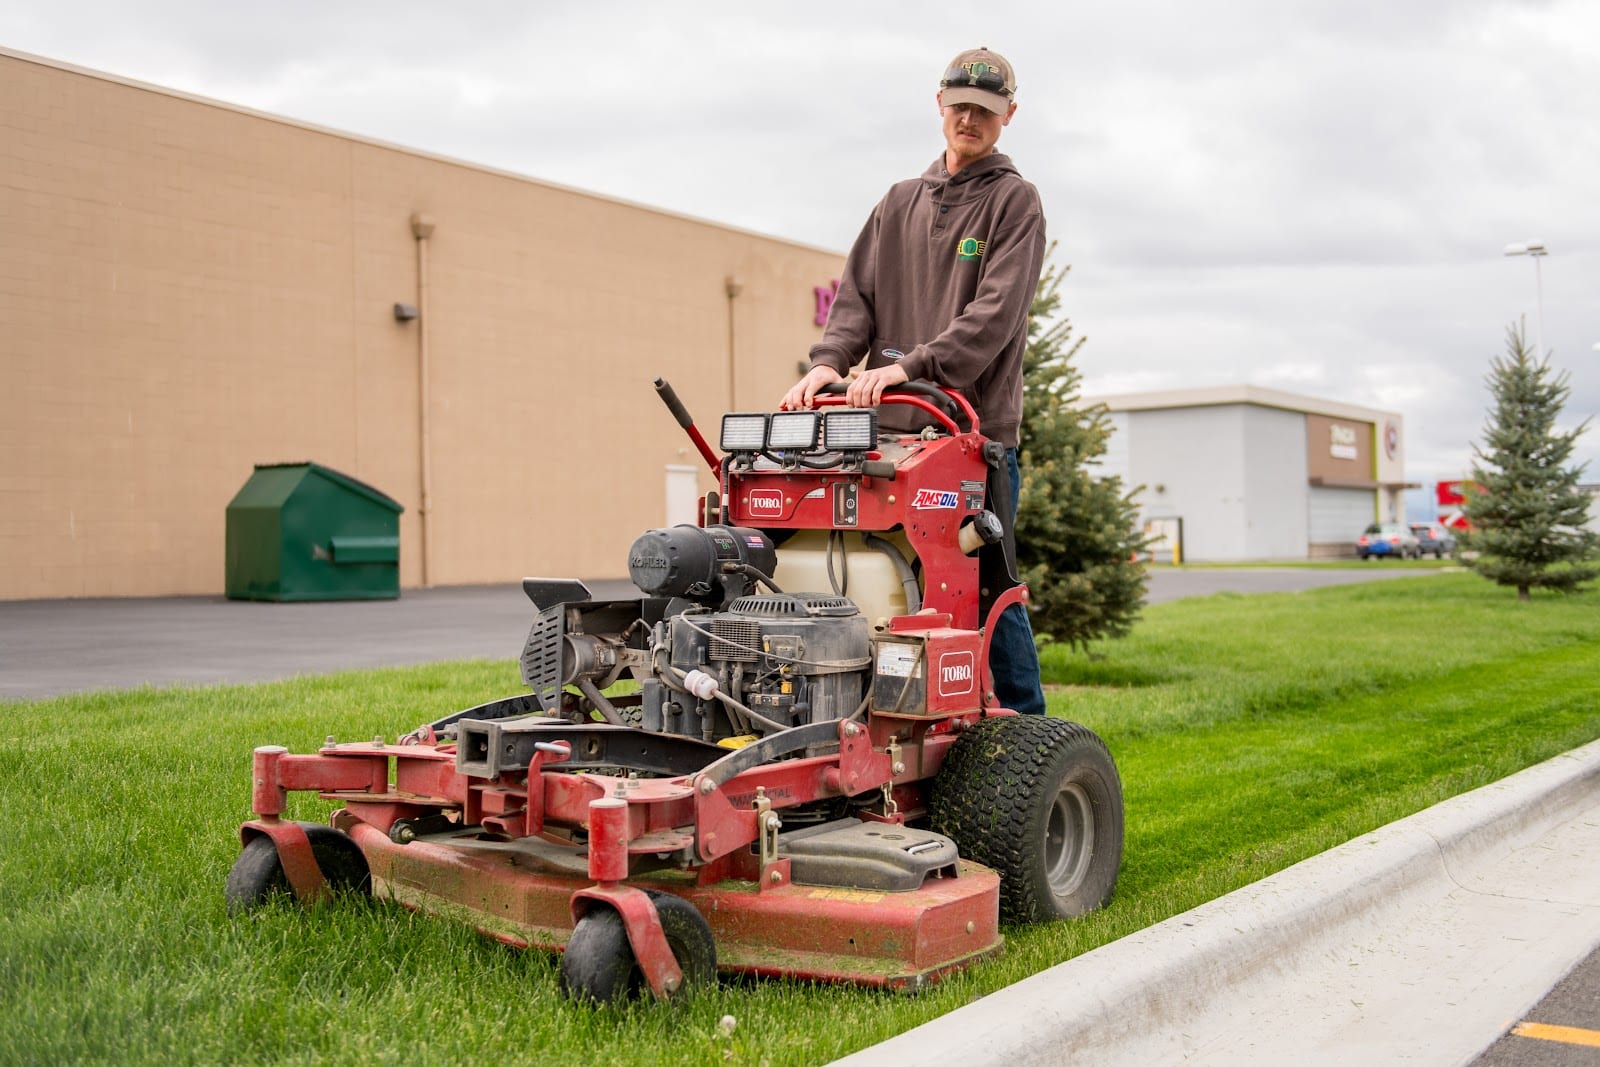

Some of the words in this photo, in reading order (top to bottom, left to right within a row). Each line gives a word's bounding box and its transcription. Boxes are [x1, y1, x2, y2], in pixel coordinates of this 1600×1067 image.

[752, 497, 780, 508] TORO
[914, 490, 957, 508] AMSOIL
[631, 556, 667, 569] KOHLER
[942, 664, 971, 682] TORO
